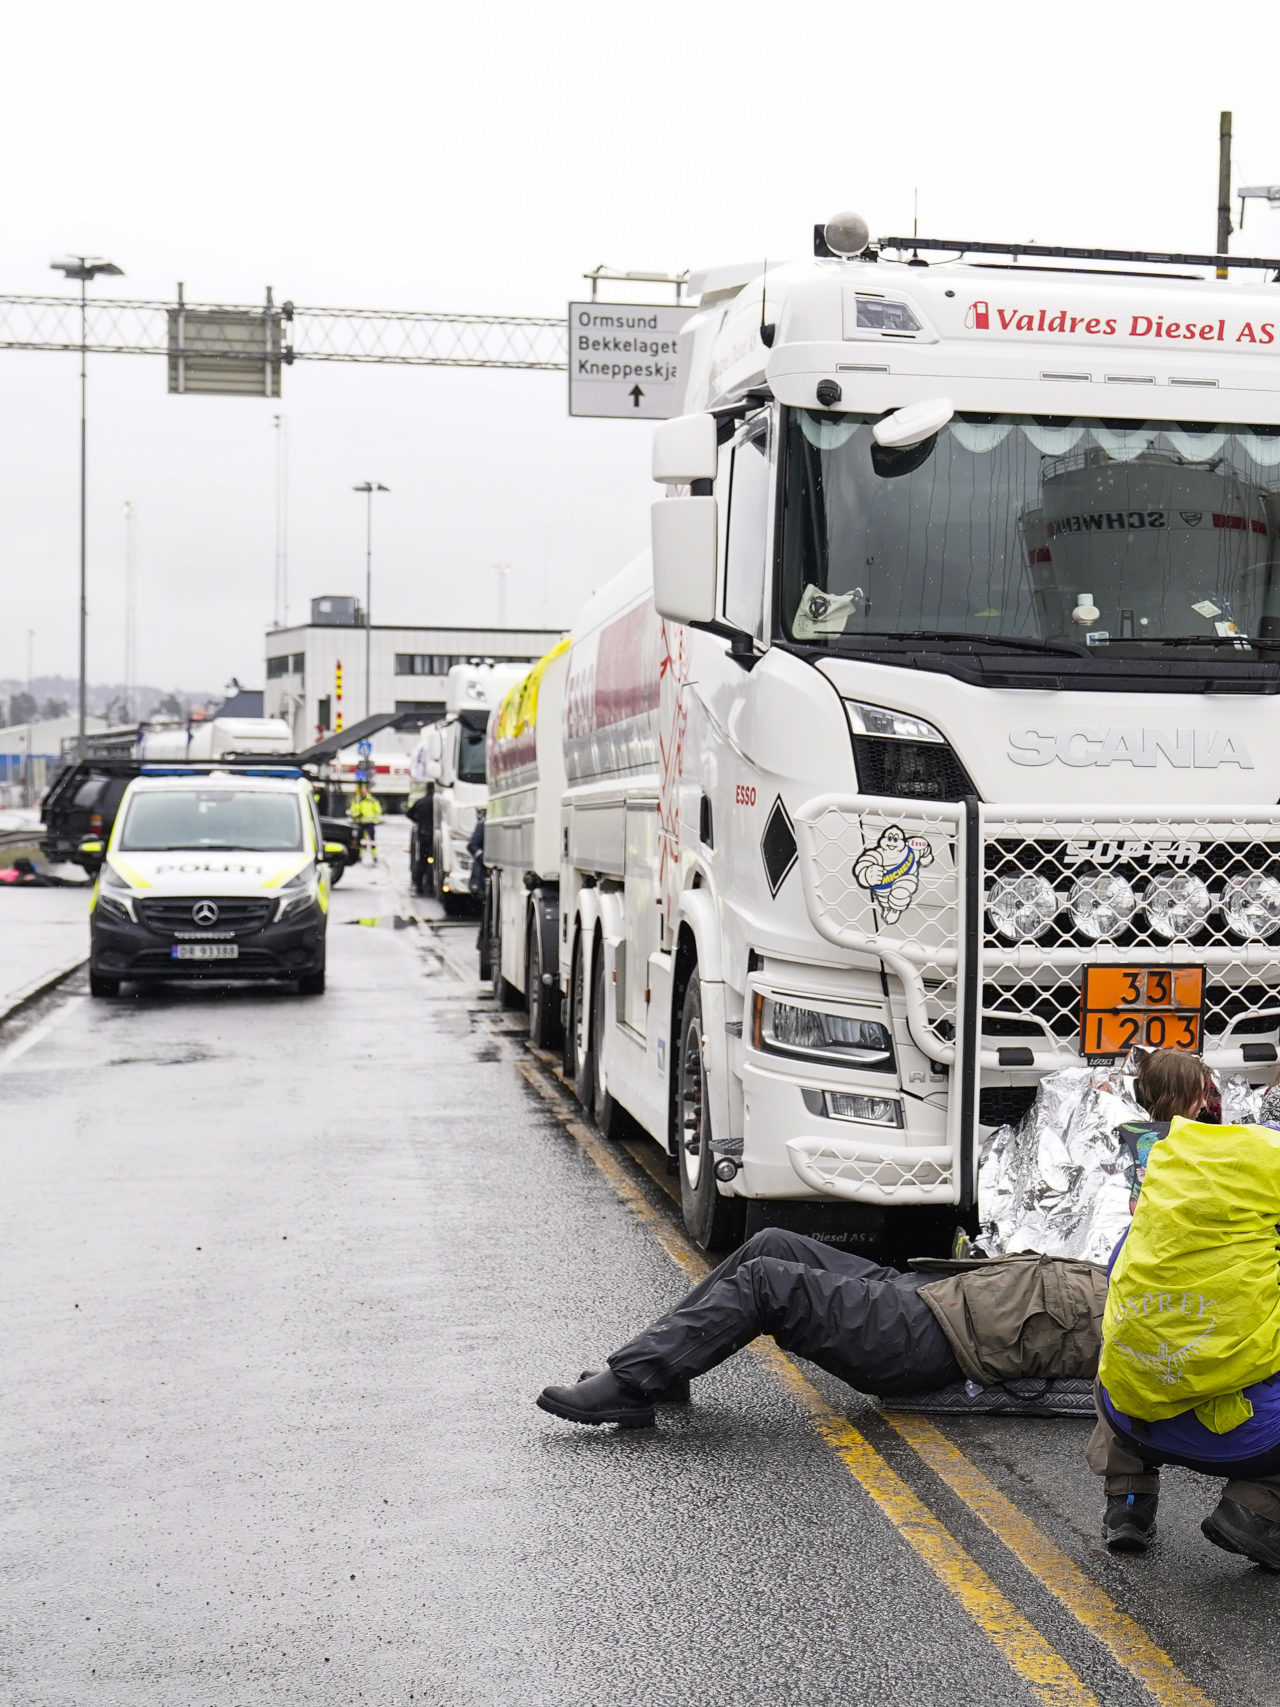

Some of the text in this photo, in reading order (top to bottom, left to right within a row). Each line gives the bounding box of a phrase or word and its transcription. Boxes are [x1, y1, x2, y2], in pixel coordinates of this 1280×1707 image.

[579, 312, 657, 329] Ormsund
[997, 309, 1275, 343] Valdres Diesel AS
[579, 336, 678, 357] Bekkelaget
[1007, 727, 1254, 769] SCANIA
[736, 785, 756, 806] ESSO
[881, 852, 915, 886] MICHELIN
[1120, 972, 1168, 1005] 33
[1096, 1015, 1196, 1050] 1203
[1114, 1291, 1216, 1325] OSPREY
